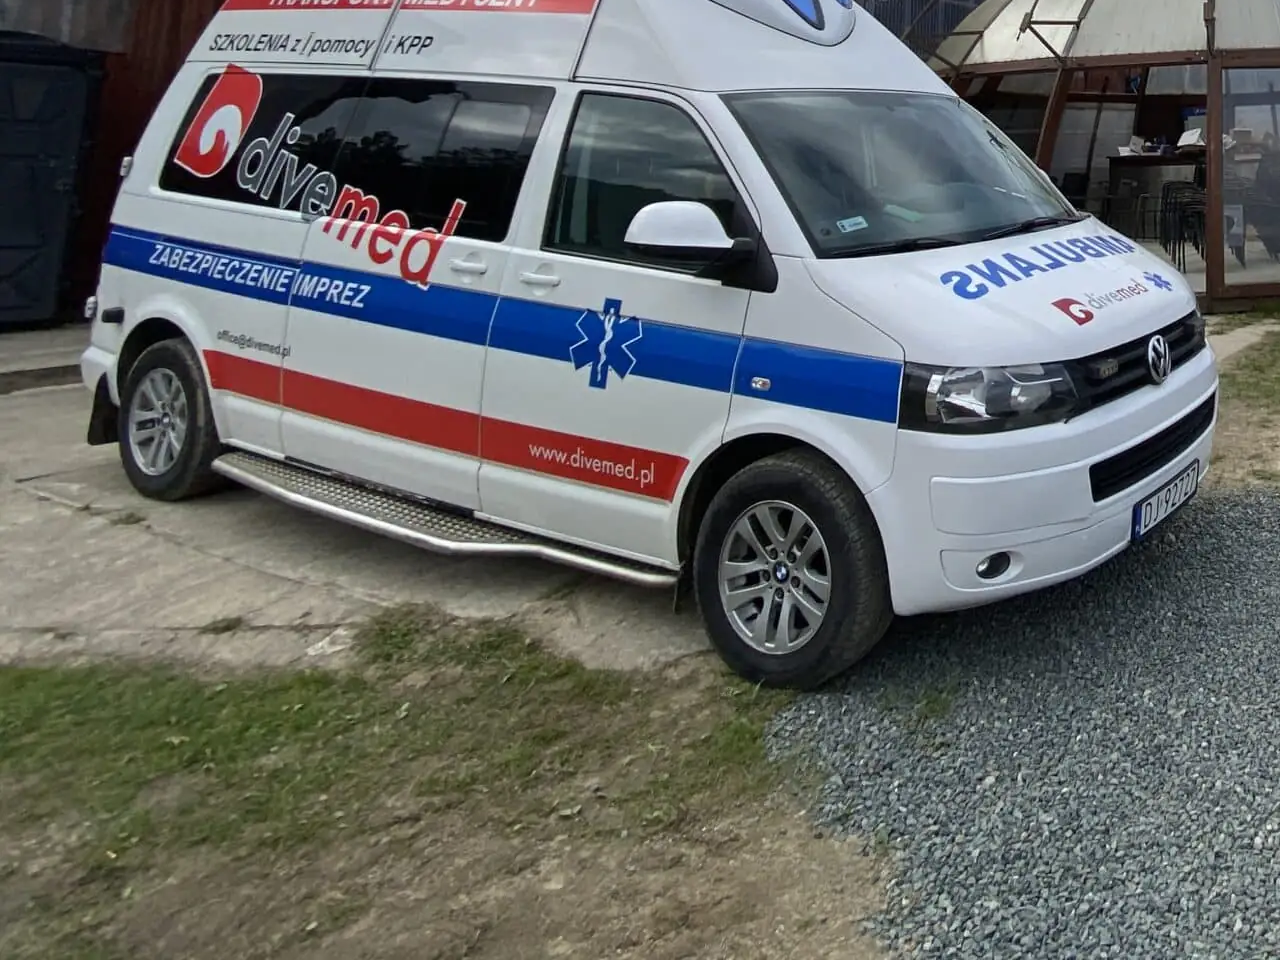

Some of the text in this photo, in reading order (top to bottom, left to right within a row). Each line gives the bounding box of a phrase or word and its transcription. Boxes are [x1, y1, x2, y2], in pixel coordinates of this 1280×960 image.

[209, 33, 291, 52] SZKOLENIA
[290, 38, 299, 52] z
[307, 39, 376, 57] pomocy
[393, 35, 434, 55] KPP
[236, 112, 467, 290] divemed
[148, 244, 371, 308] ZABEZPIECZENIE IMPREZ
[1085, 278, 1148, 310] divemed
[217, 329, 291, 359] office@divemed.pl
[528, 443, 655, 488] www.divemed.pl
[1143, 466, 1197, 530] DJ 92727
